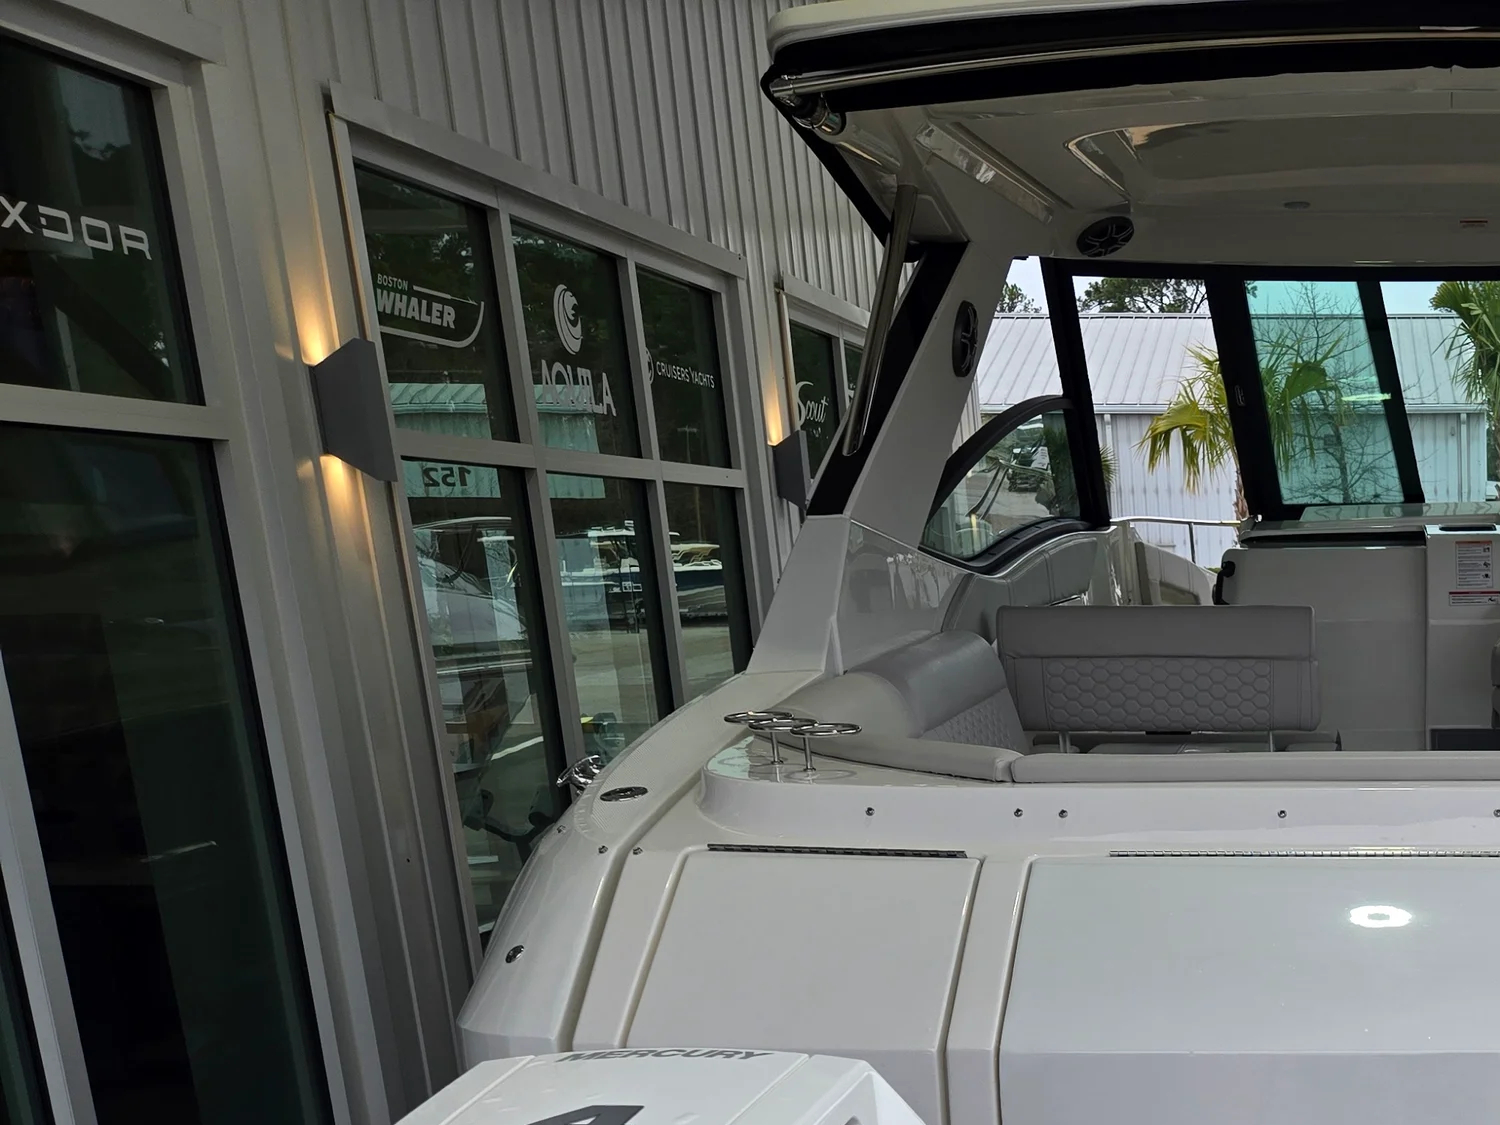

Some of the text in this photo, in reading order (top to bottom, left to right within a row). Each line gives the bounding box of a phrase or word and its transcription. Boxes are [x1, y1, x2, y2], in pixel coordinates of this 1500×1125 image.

[377, 273, 408, 291] BOSTON
[376, 287, 455, 329] WHALER
[540, 359, 617, 417] AQUILA
[656, 361, 715, 389] CRUISERS YACHTS
[556, 1049, 772, 1063] MERCURY
